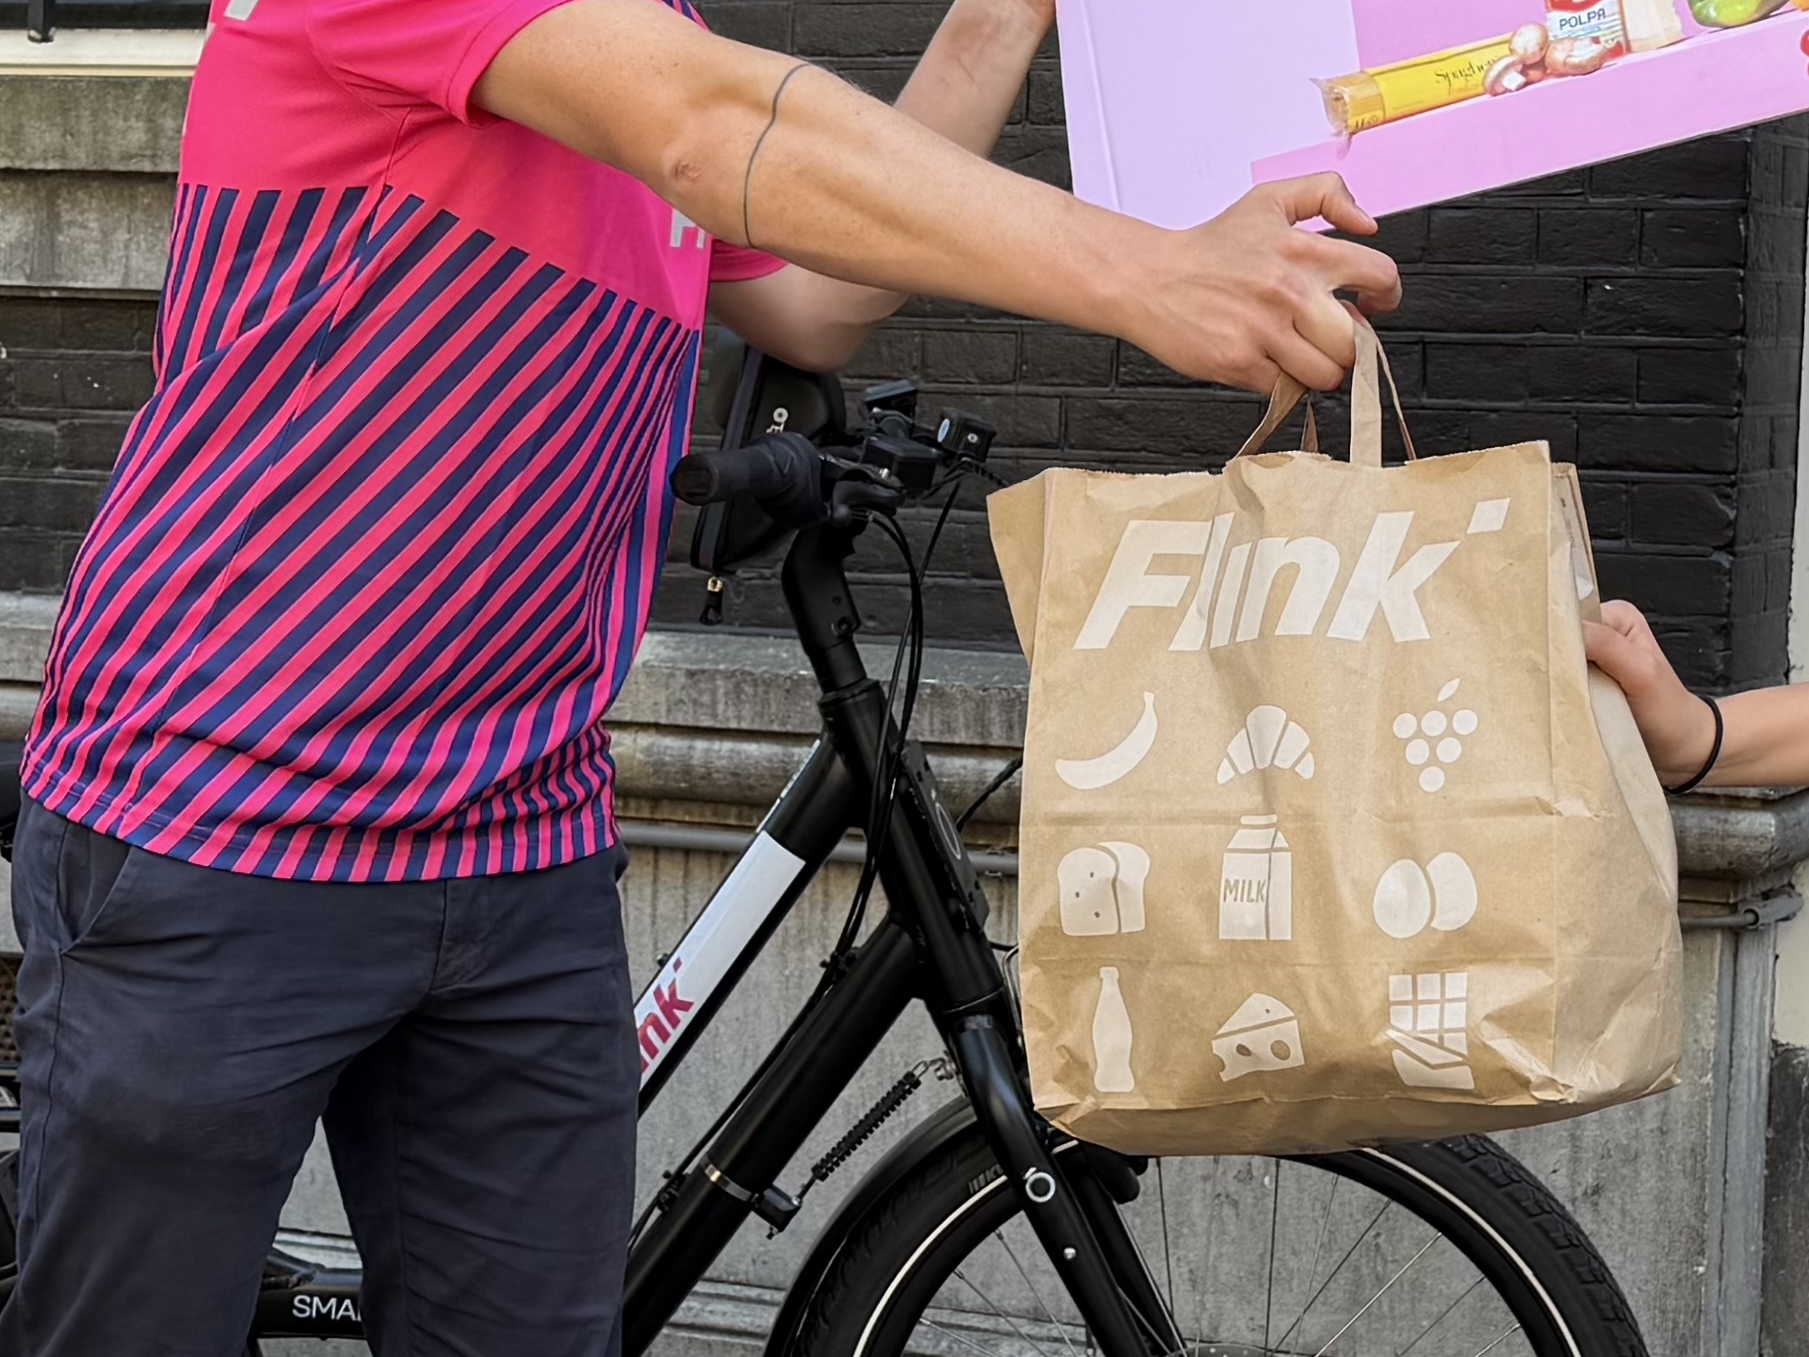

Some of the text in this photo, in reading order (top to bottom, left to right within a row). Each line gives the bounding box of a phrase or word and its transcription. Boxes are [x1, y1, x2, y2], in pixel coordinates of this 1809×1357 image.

[1558, 8, 1606, 31] POLPA
[1073, 497, 1512, 652] Flink
[1223, 878, 1267, 903] MILK
[292, 1294, 362, 1322] SMA
